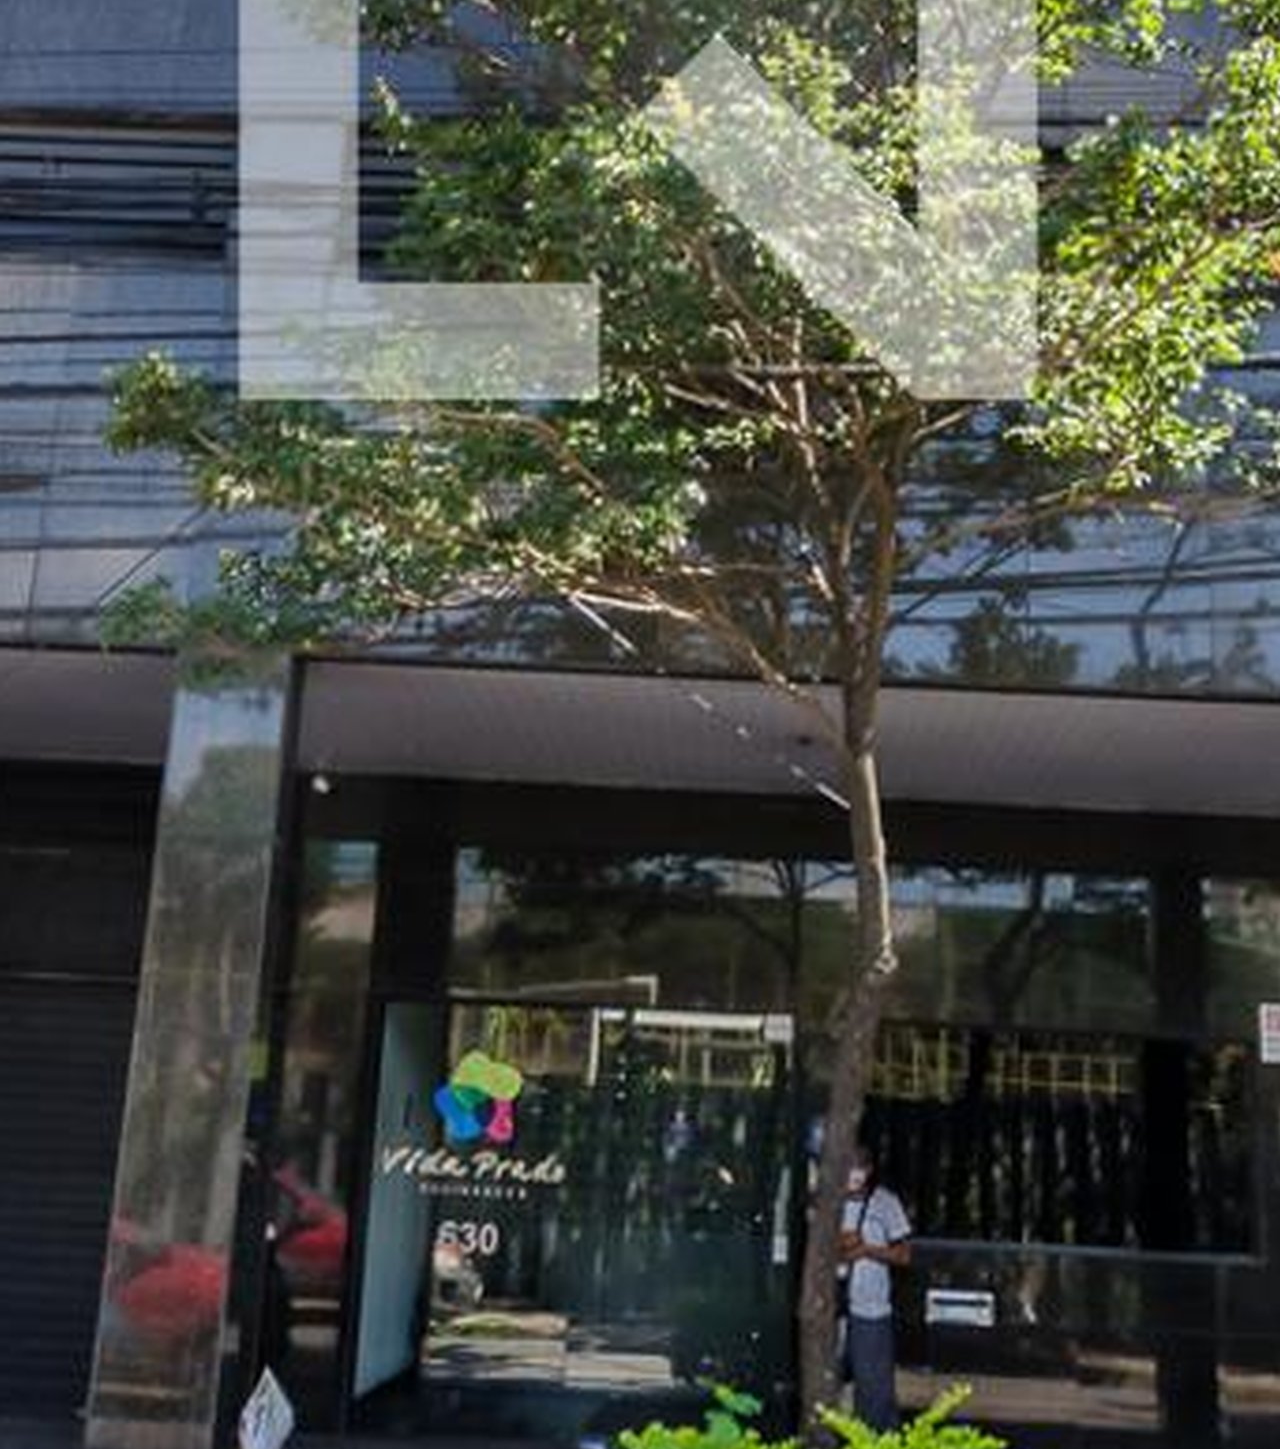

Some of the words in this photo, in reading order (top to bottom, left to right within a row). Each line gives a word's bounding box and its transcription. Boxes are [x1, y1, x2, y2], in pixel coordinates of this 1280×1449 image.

[383, 1147, 468, 1175] Vida
[470, 1152, 567, 1183] Prado
[437, 1220, 500, 1256] 630
